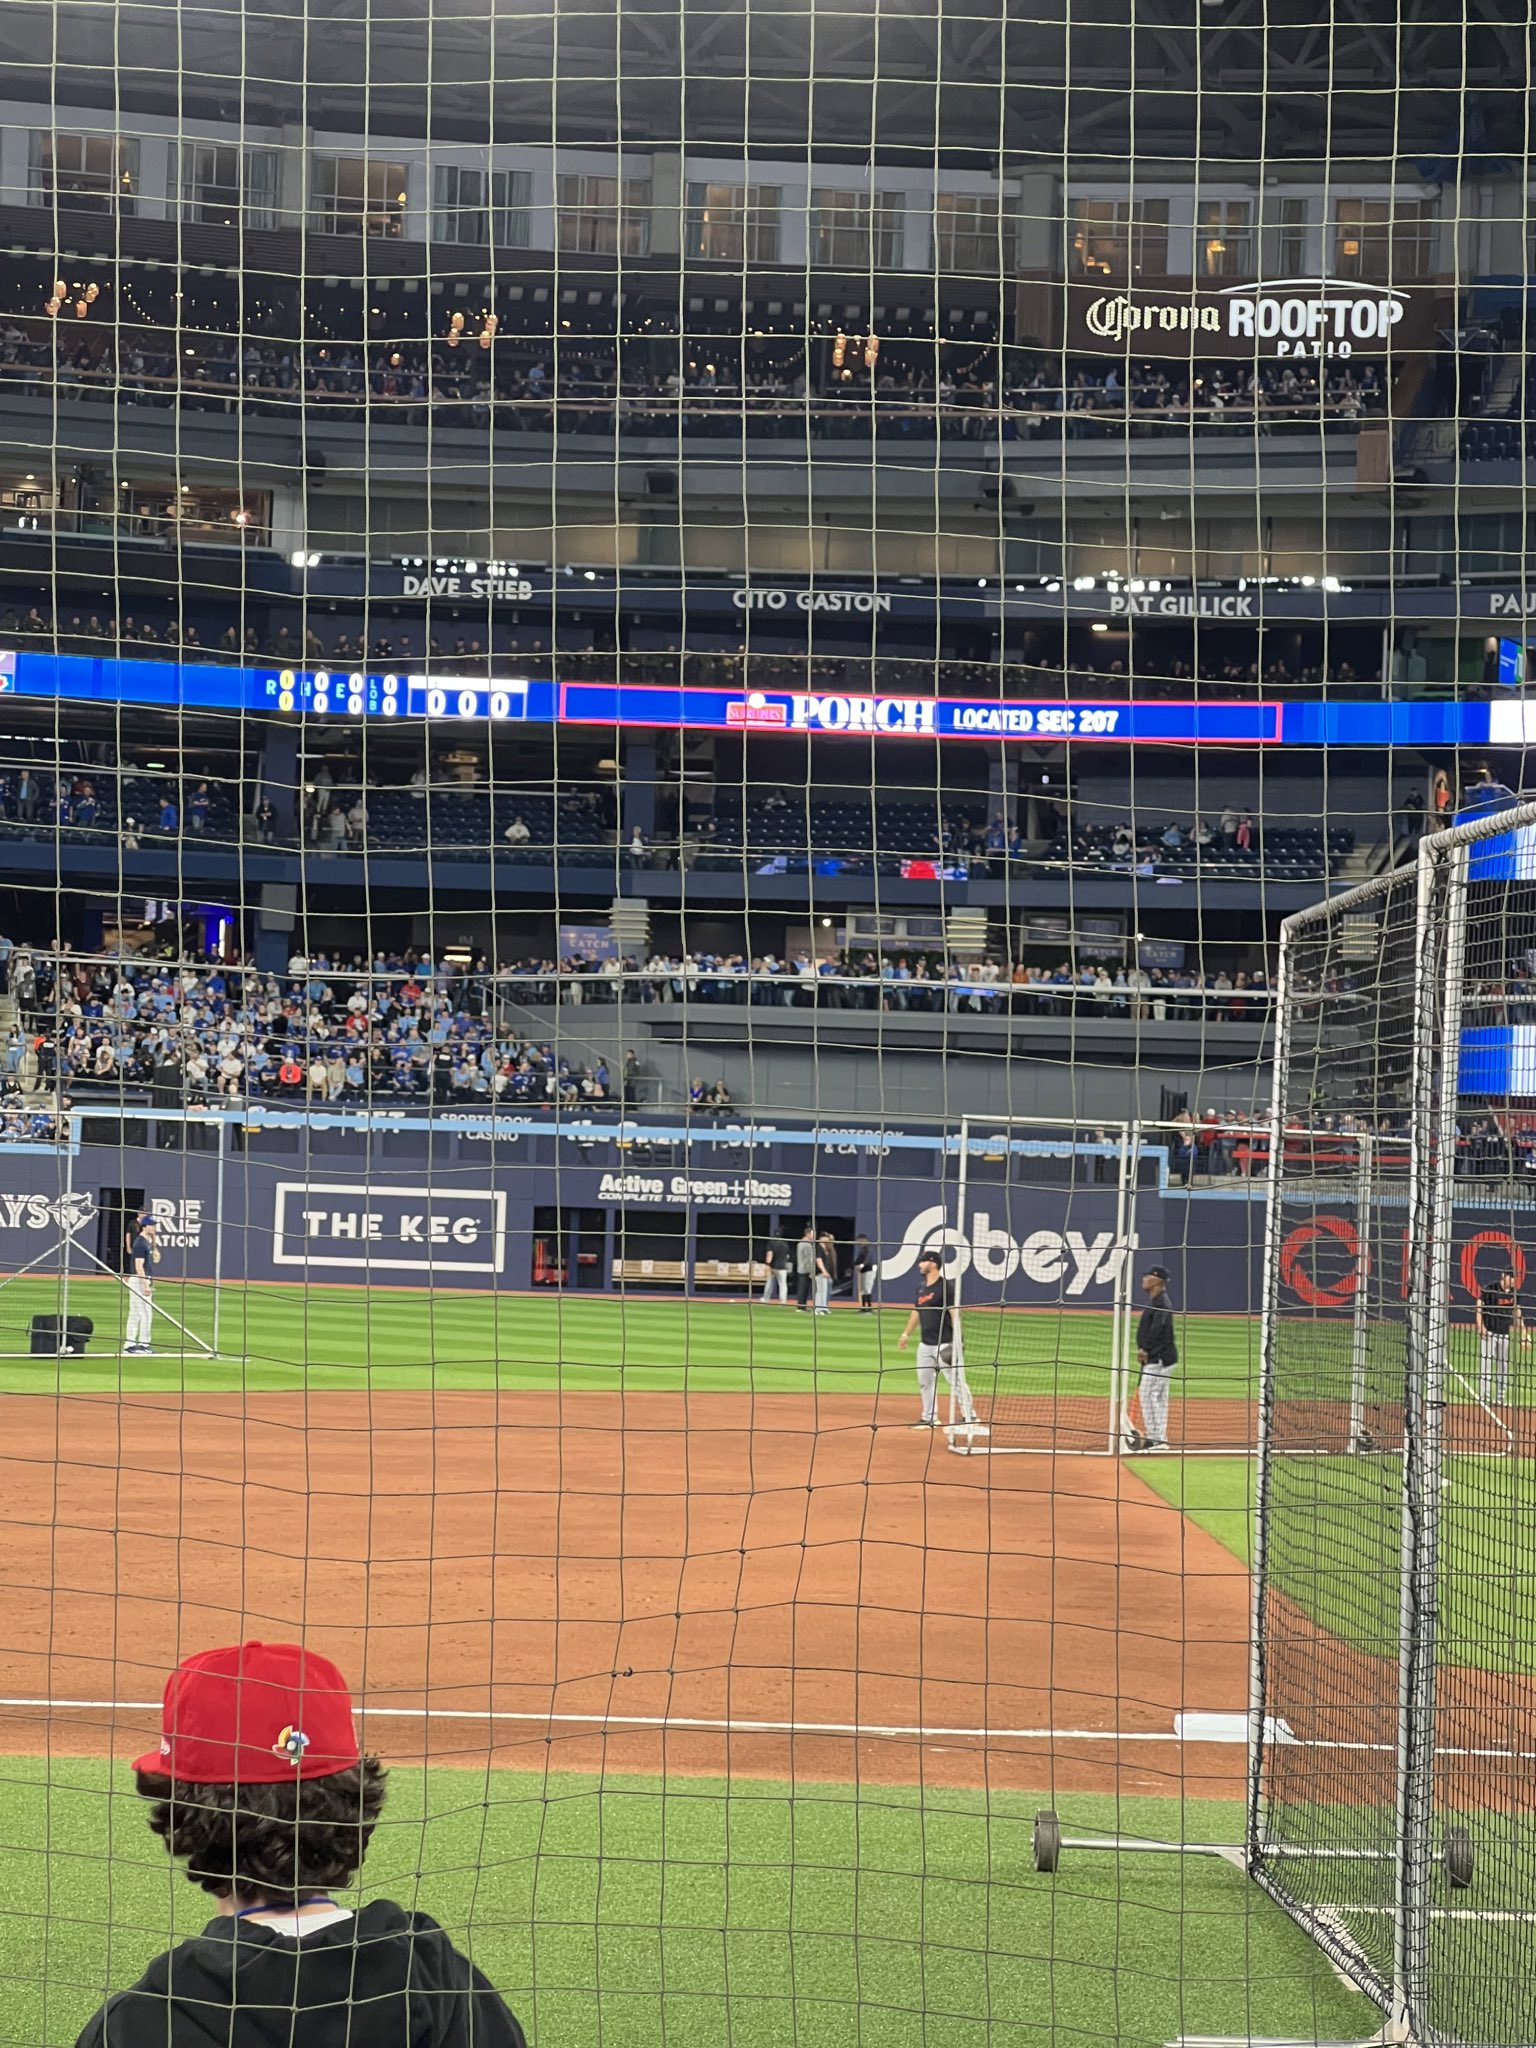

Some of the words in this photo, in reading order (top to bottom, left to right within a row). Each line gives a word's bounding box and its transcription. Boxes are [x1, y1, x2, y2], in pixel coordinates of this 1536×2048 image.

[1086, 295, 1220, 341] Corona
[1229, 299, 1403, 337] ROOFTOP
[1277, 341, 1351, 358] PATIO
[403, 576, 461, 597] DAVE
[471, 579, 532, 600] STIEB
[733, 590, 787, 609] CITO
[796, 592, 890, 612] GASTON
[1110, 597, 1154, 616] PAT
[1160, 596, 1252, 617] GILLICK
[265, 679, 277, 695] R
[336, 683, 346, 698] E
[791, 695, 935, 732] PORCH
[953, 708, 1033, 731] LOCATED
[1037, 710, 1075, 732] SEC
[1079, 710, 1119, 732] 207
[838, 1143, 890, 1156] CAINO
[599, 1174, 663, 1194] Active
[598, 1192, 662, 1202] COMPLETE
[666, 1194, 690, 1203] TIRE
[707, 1196, 739, 1206] AUTO
[743, 1197, 791, 1207] CENTRE
[303, 1211, 383, 1240] THE
[400, 1215, 478, 1244] KEG
